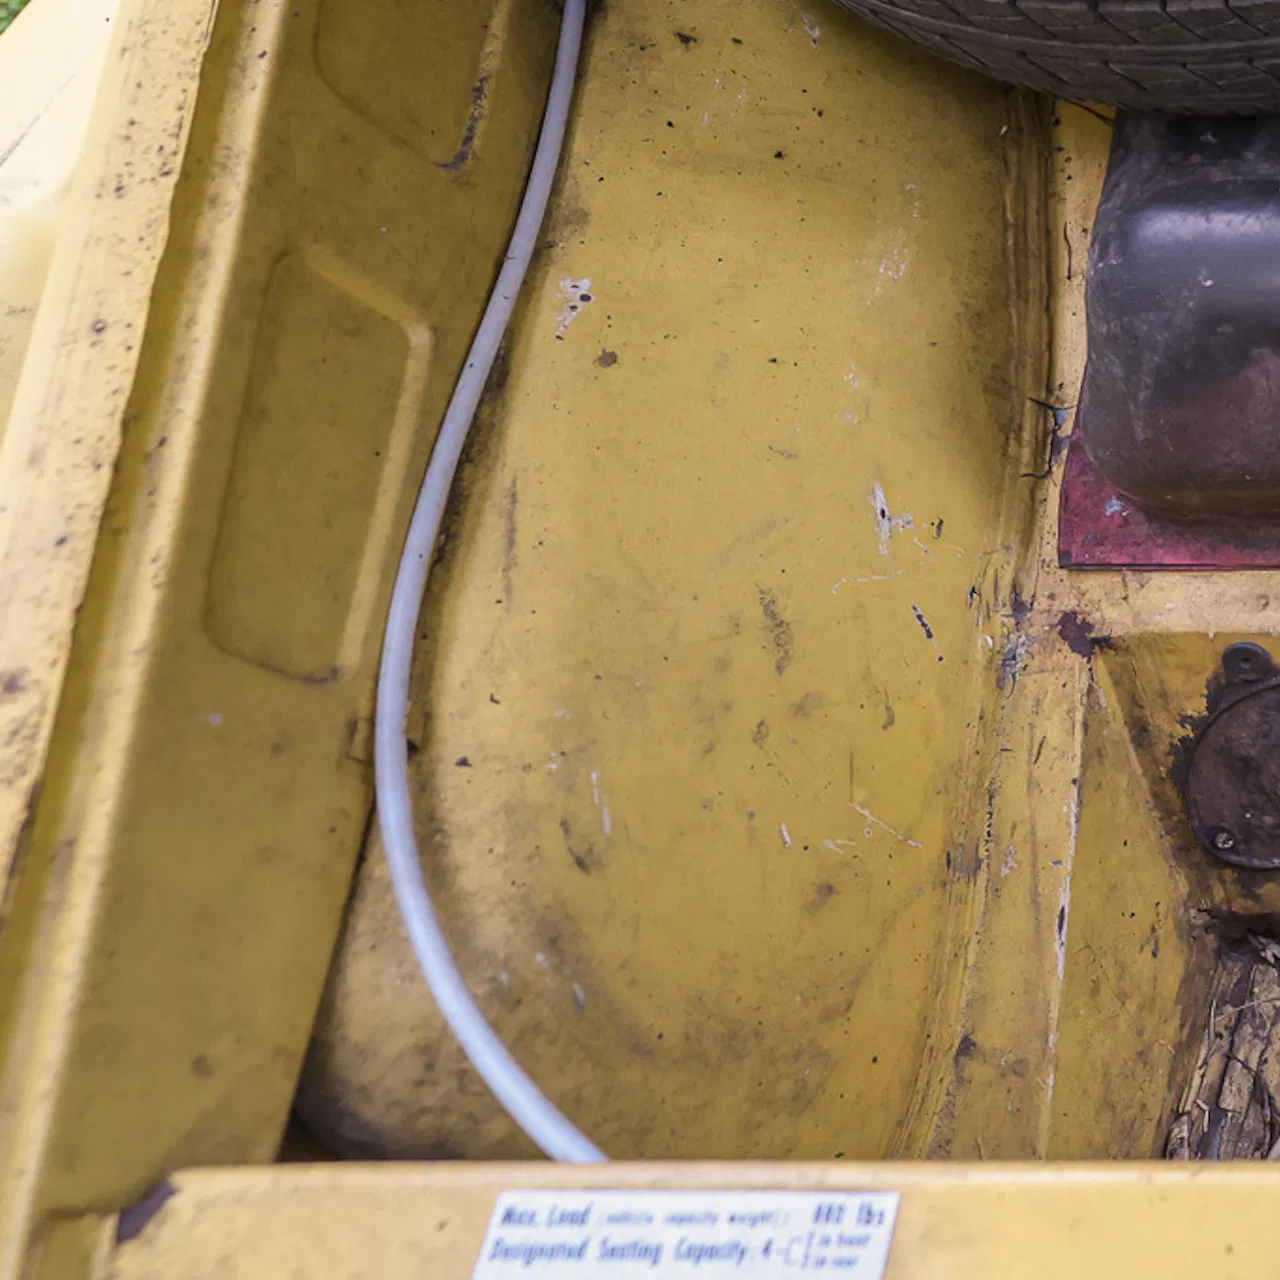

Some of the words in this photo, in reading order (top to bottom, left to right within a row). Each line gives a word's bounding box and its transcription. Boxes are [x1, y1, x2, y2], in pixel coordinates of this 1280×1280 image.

[547, 1200, 594, 1228] Load
[488, 1233, 592, 1268] Designated
[598, 1232, 664, 1268] Seating
